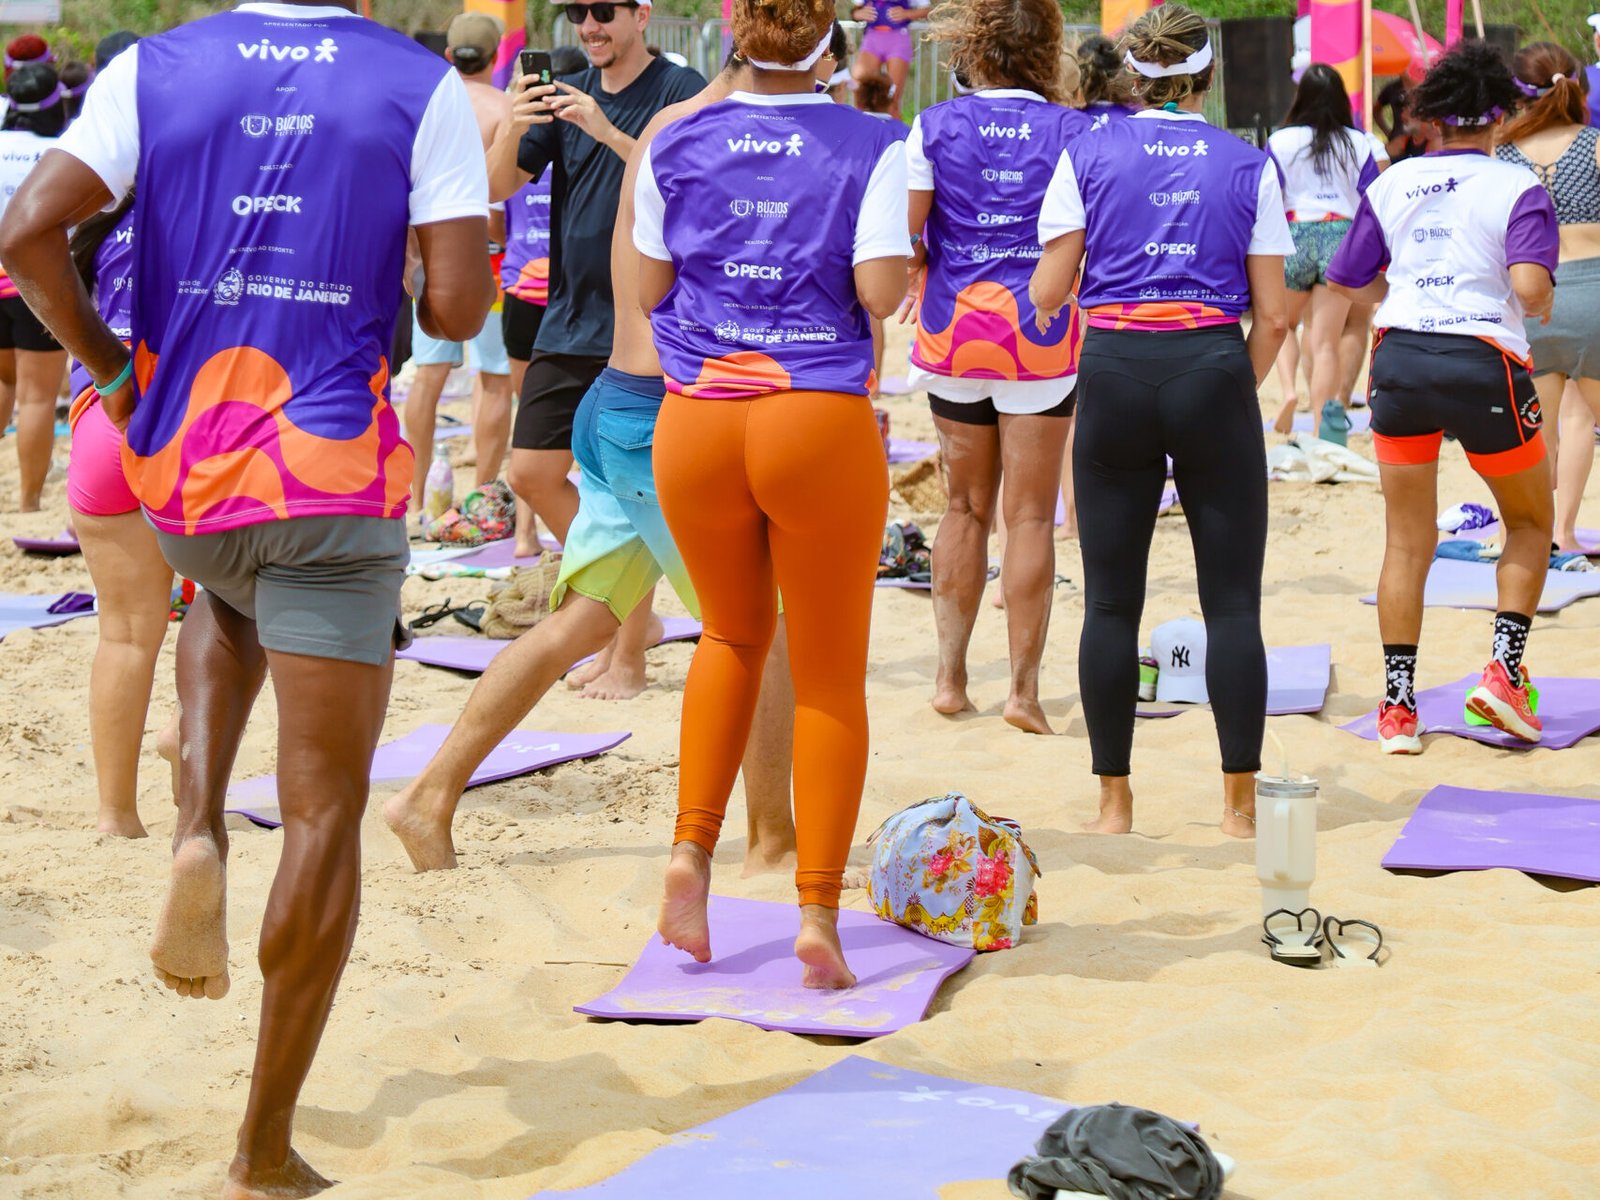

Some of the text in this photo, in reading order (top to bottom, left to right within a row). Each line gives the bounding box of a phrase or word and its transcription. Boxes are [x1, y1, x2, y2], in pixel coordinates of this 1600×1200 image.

[237, 38, 311, 61] vivo
[275, 113, 316, 132] BÚZIOS
[978, 121, 1017, 139] vivo
[727, 133, 782, 154] vivo
[1143, 140, 1190, 157] vivo
[999, 168, 1025, 181] BÚZIOS
[1171, 189, 1201, 202] BÚZIOS
[1405, 183, 1443, 200] vivo
[253, 194, 303, 213] PECK
[756, 199, 789, 214] BÚZIOS
[1160, 243, 1197, 256] PECK
[739, 263, 783, 281] PECK
[247, 274, 296, 286] GOVERNO
[300, 280, 314, 288] DO
[1426, 275, 1455, 288] PECK
[246, 283, 350, 305] RIO DE JANEIRO
[1438, 316, 1455, 327] RIO
[742, 332, 838, 344] RIO DE JANEIRO
[1171, 645, 1191, 669] NY
